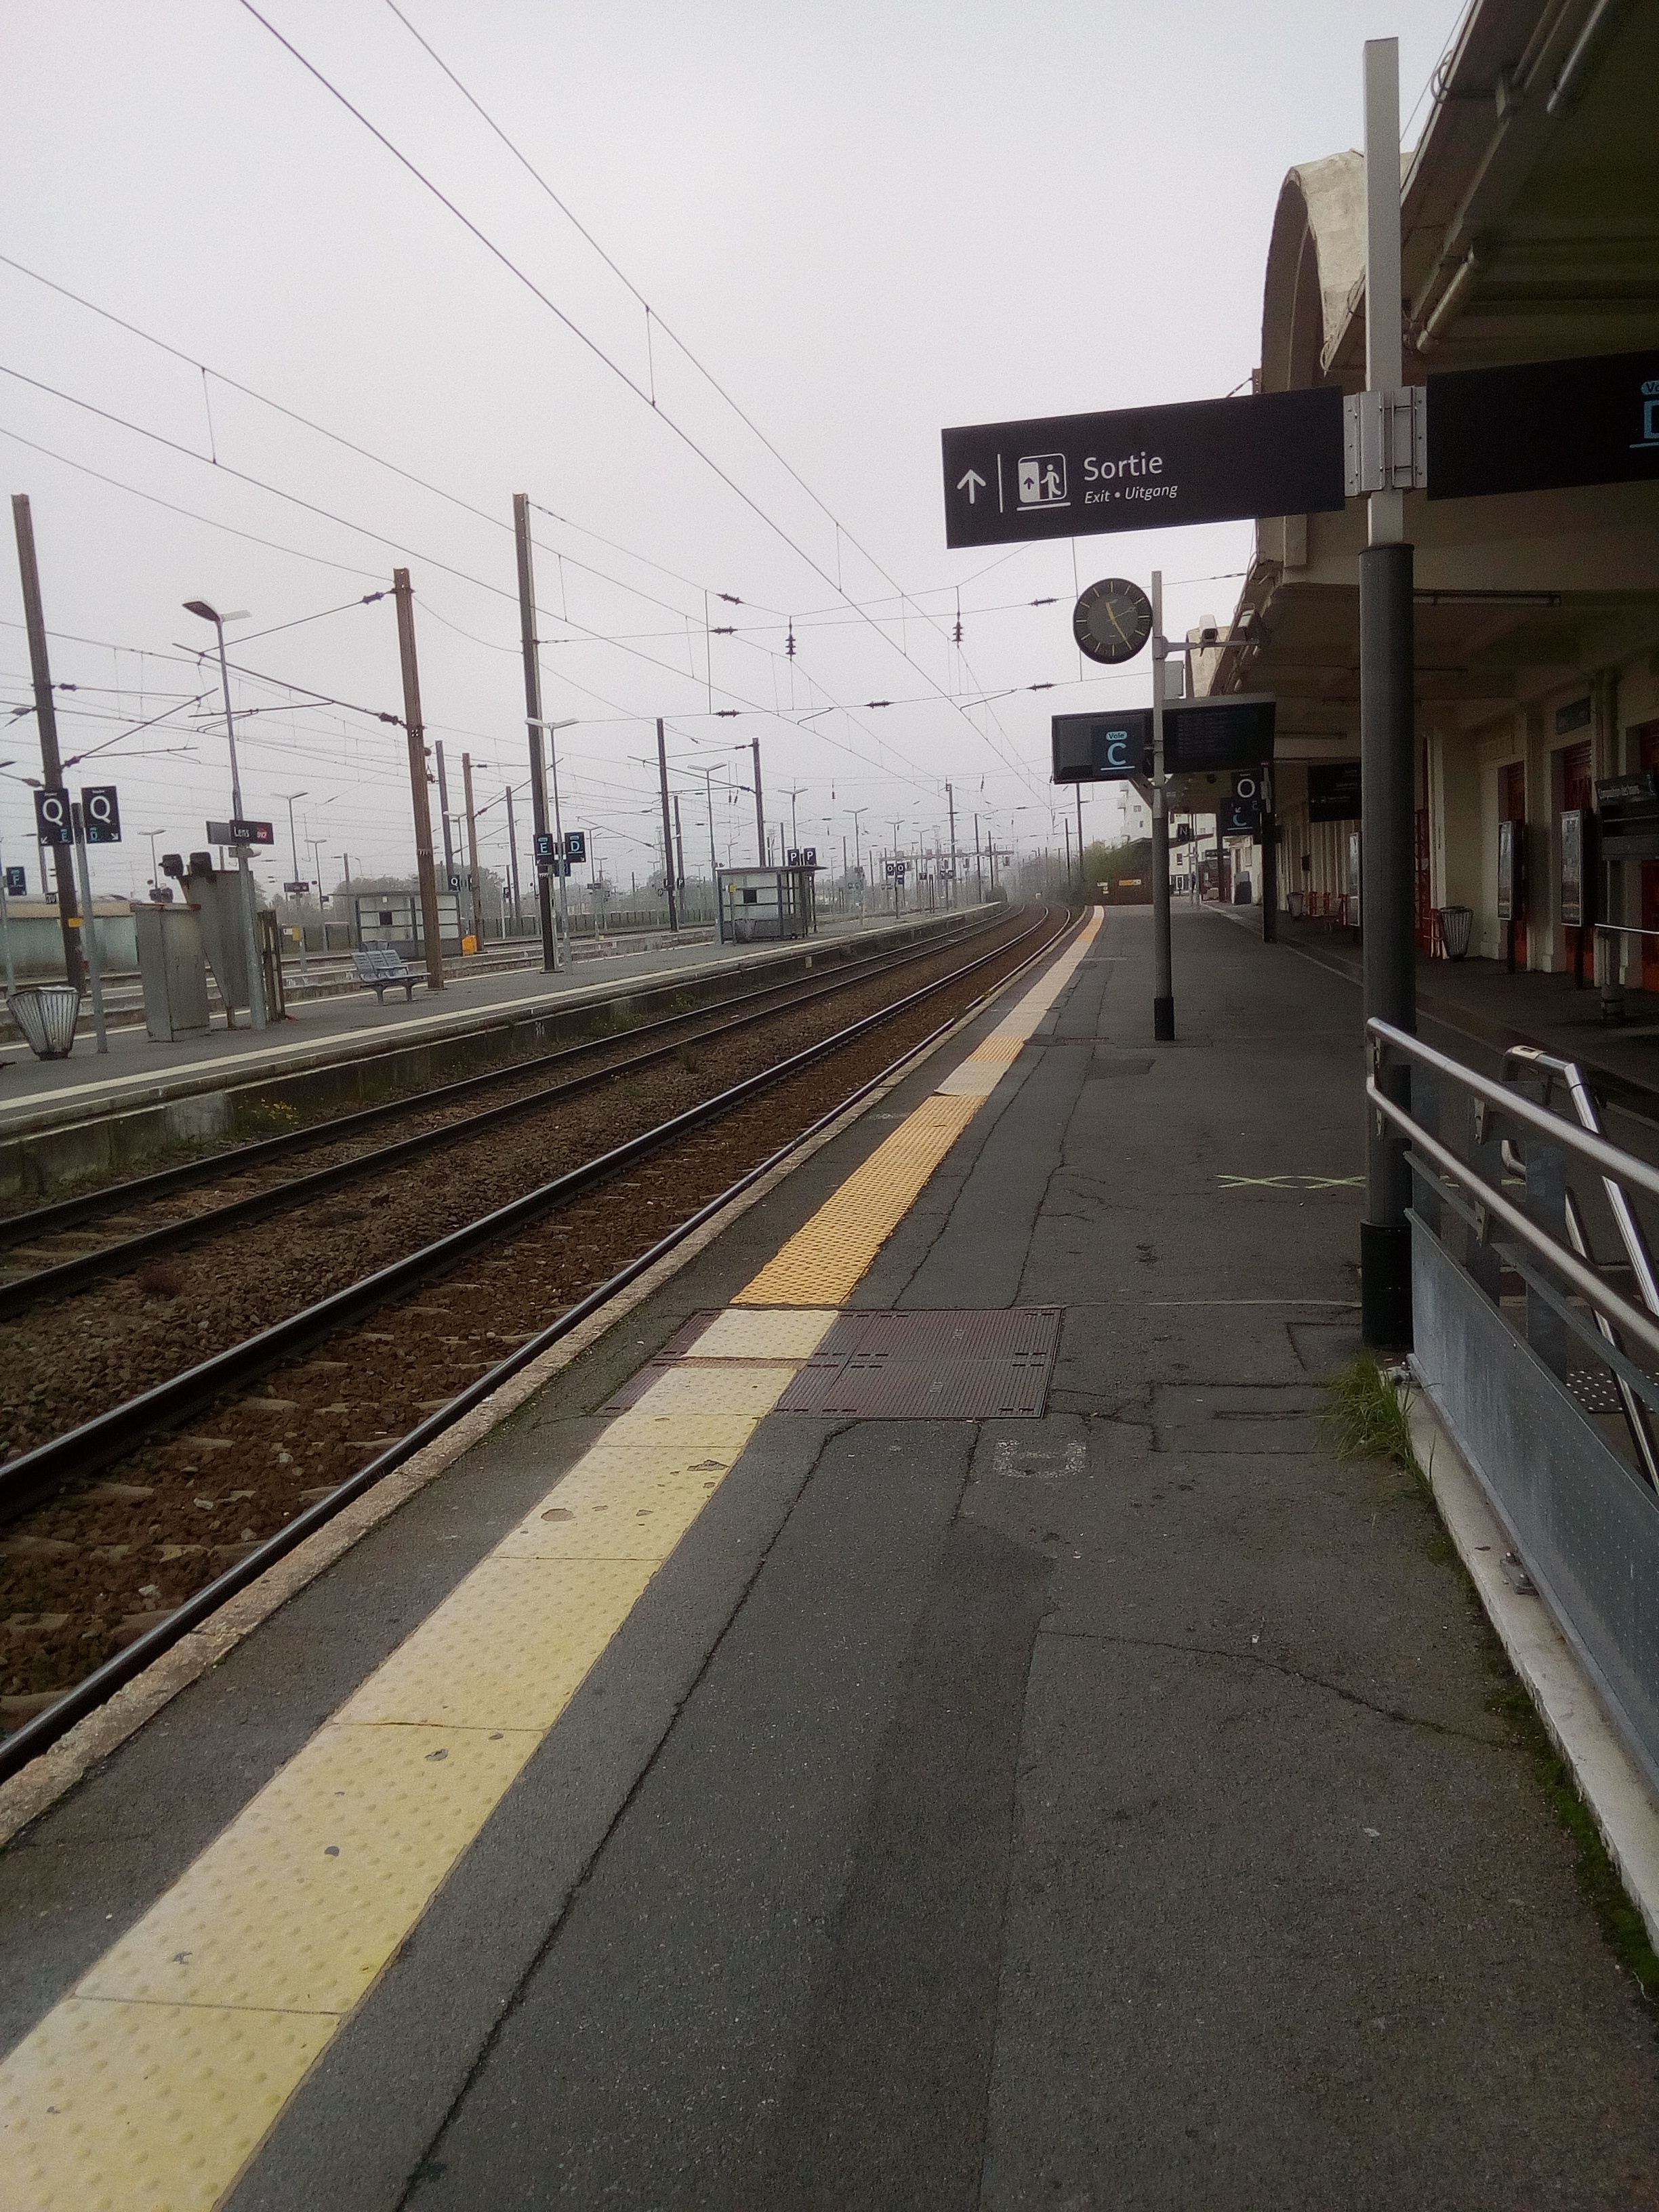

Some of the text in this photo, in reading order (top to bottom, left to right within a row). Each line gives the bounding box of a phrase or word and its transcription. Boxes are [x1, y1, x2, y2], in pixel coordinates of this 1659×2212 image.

[1084, 451, 1163, 481] Sortie
[1084, 485, 1179, 504] Exit Uitgang
[1107, 742, 1127, 766] C
[1237, 778, 1256, 798] O
[42, 798, 64, 827] Q
[89, 795, 112, 824] Q
[233, 826, 250, 838] Lens
[1179, 825, 1188, 836] N
[539, 842, 548, 853] E
[571, 840, 580, 852] D
[790, 852, 797, 862] P
[806, 851, 814, 861] P
[451, 877, 458, 887] Q
